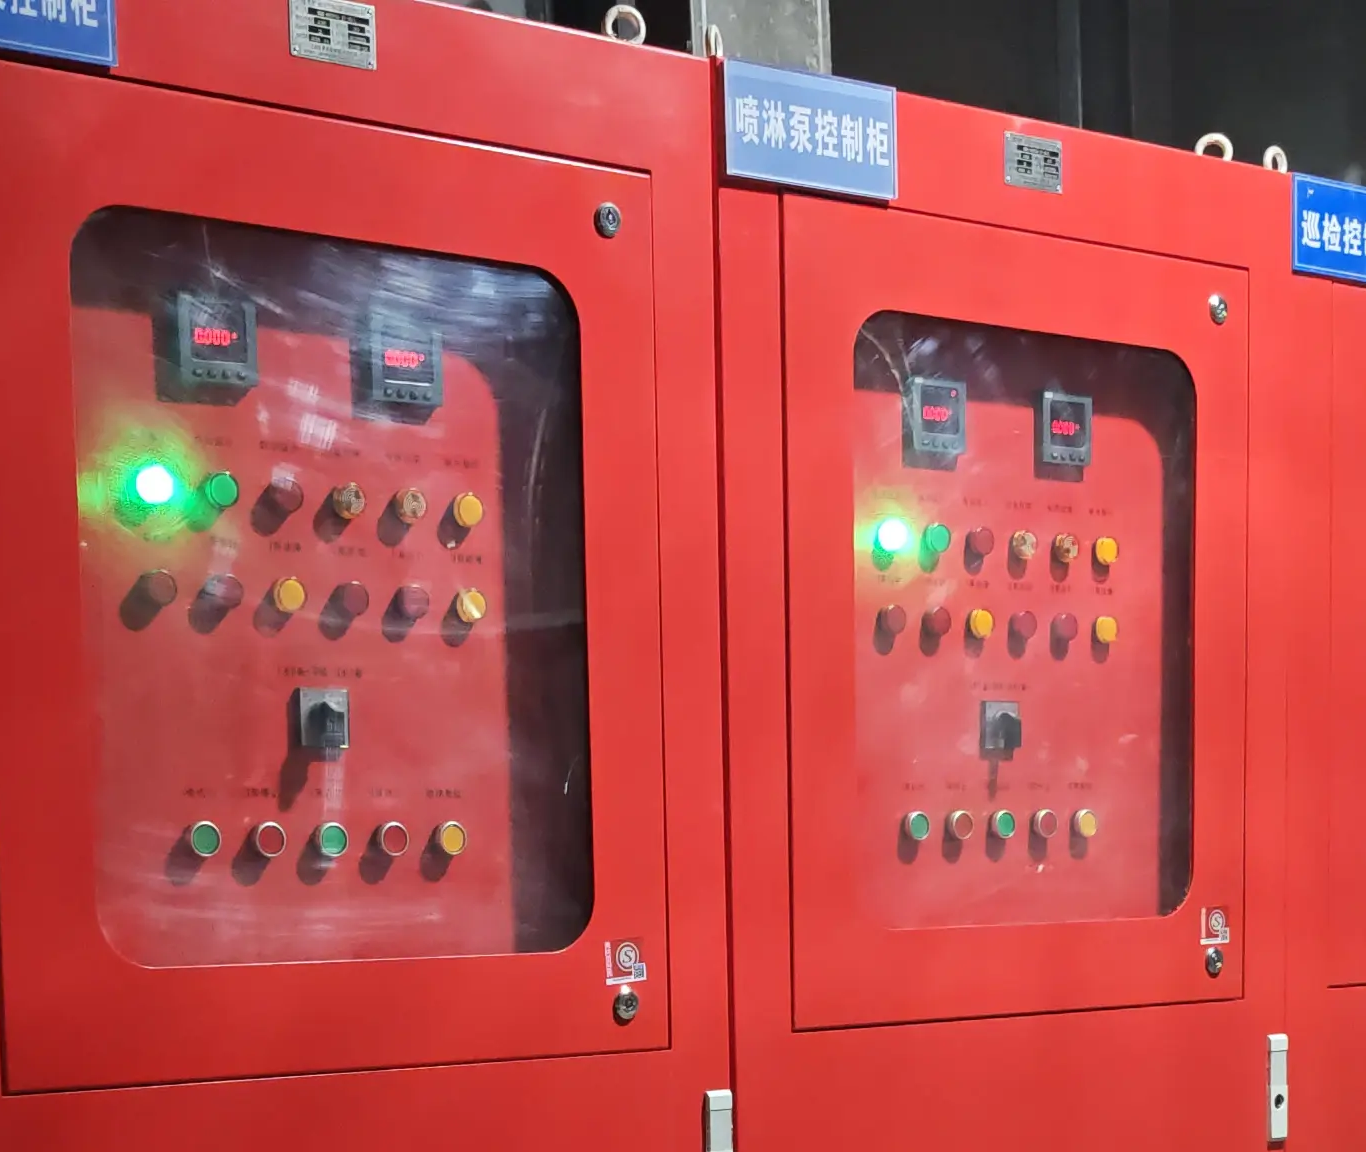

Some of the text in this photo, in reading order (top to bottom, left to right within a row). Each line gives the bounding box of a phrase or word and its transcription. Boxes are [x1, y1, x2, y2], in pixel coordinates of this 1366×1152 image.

[734, 96, 890, 167] 喷淋泵控制柜
